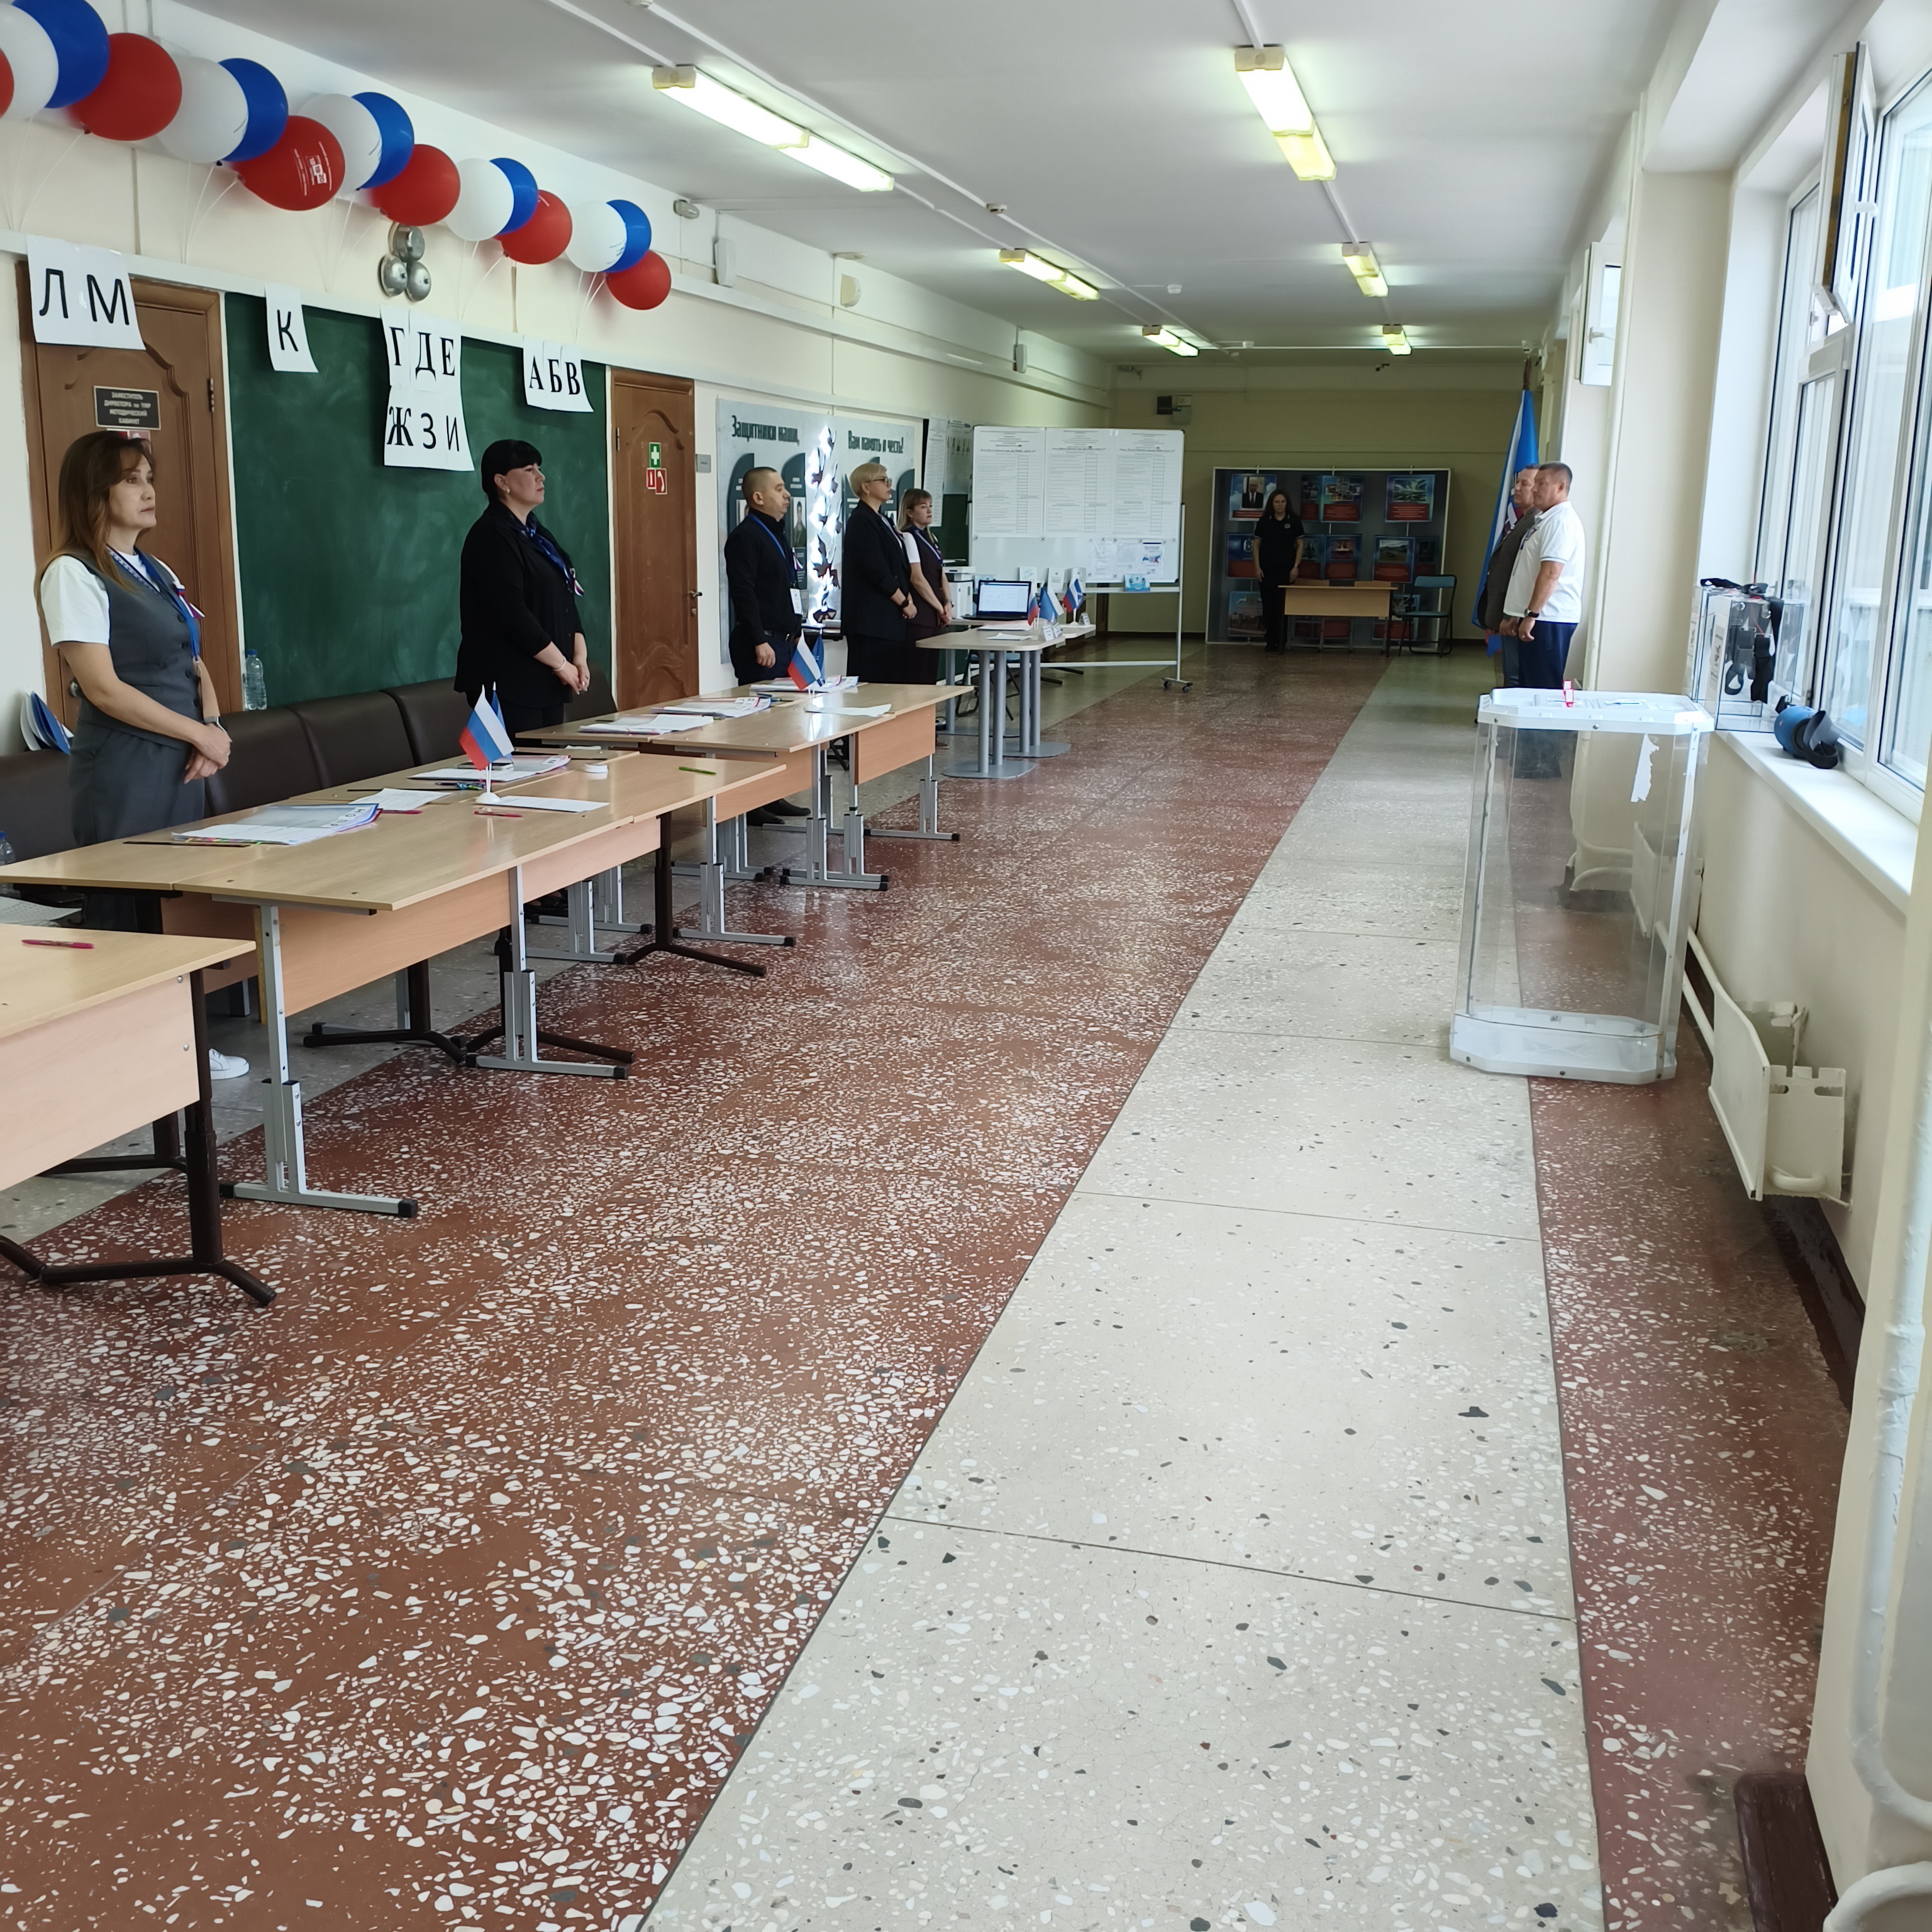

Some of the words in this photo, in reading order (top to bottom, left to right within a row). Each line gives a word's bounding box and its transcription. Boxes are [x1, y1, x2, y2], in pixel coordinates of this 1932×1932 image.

[277, 309, 299, 352] К
[731, 415, 777, 442] Защитники
[848, 430, 860, 450] Вам
[882, 439, 887, 452] и
